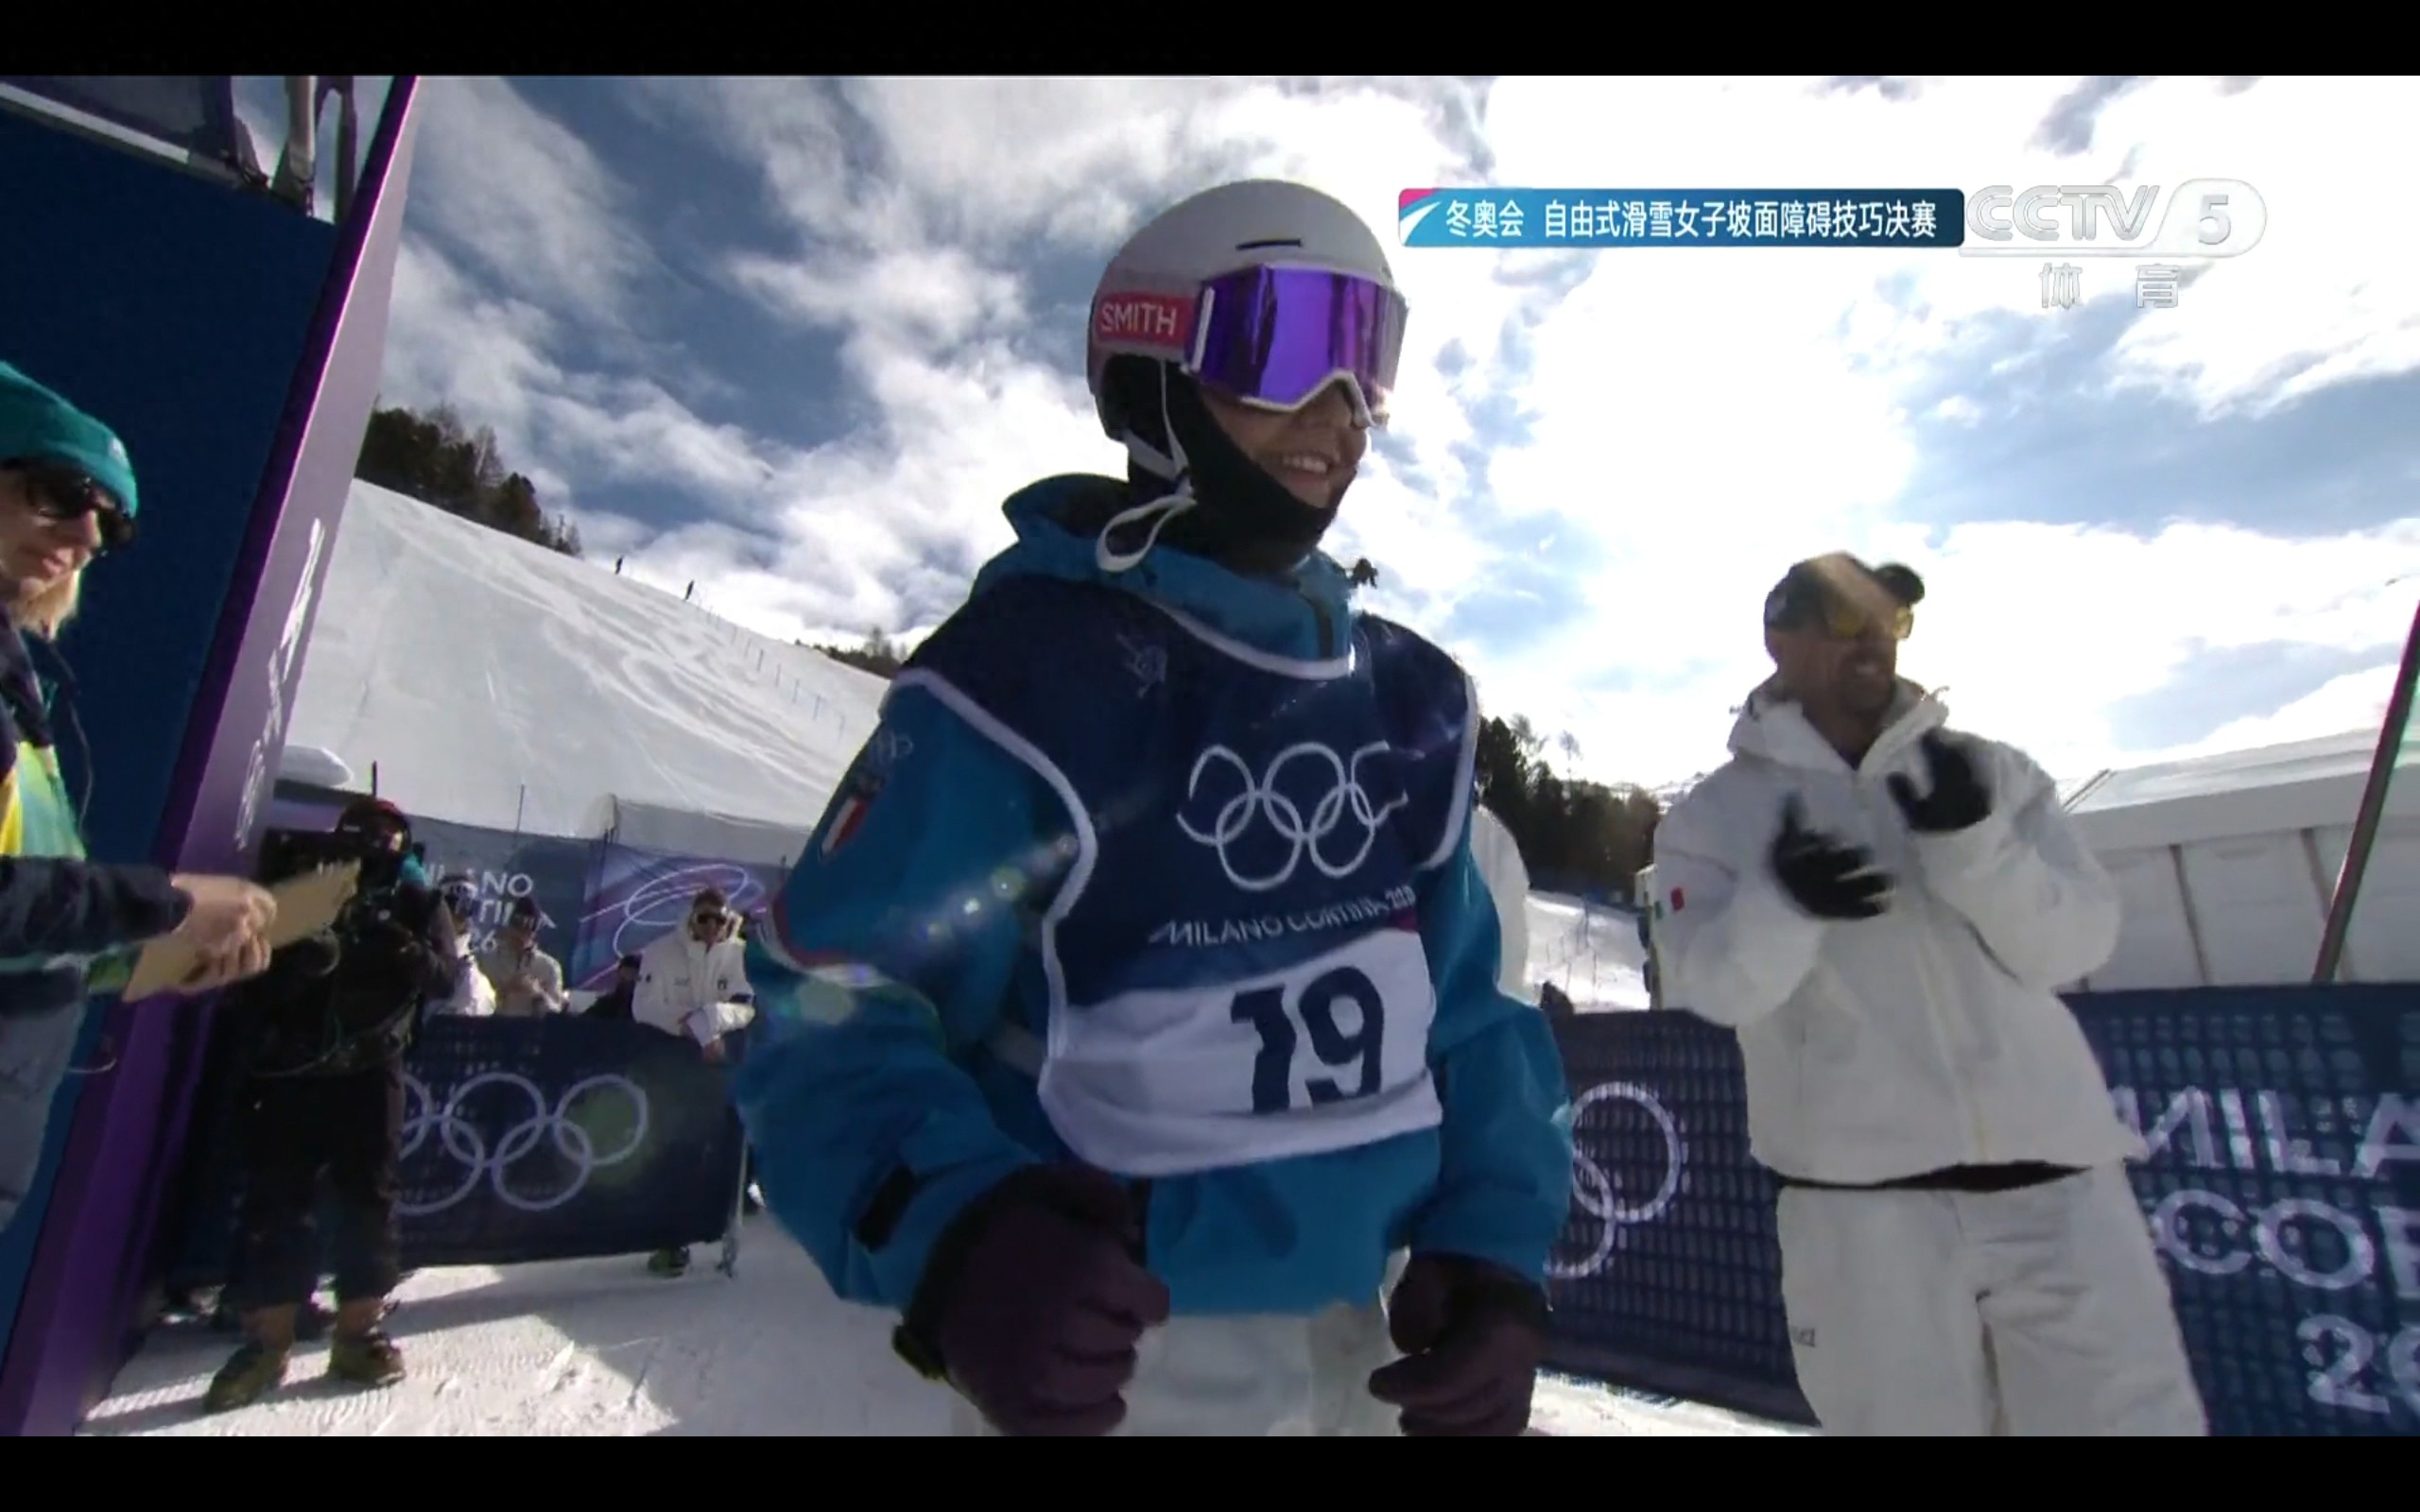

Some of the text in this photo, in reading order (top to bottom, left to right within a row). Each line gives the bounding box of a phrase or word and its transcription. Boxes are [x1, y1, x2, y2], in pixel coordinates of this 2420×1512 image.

[1100, 301, 1177, 336] SMITH
[1149, 914, 1283, 946] MILANO
[1231, 966, 1384, 1114] 19
